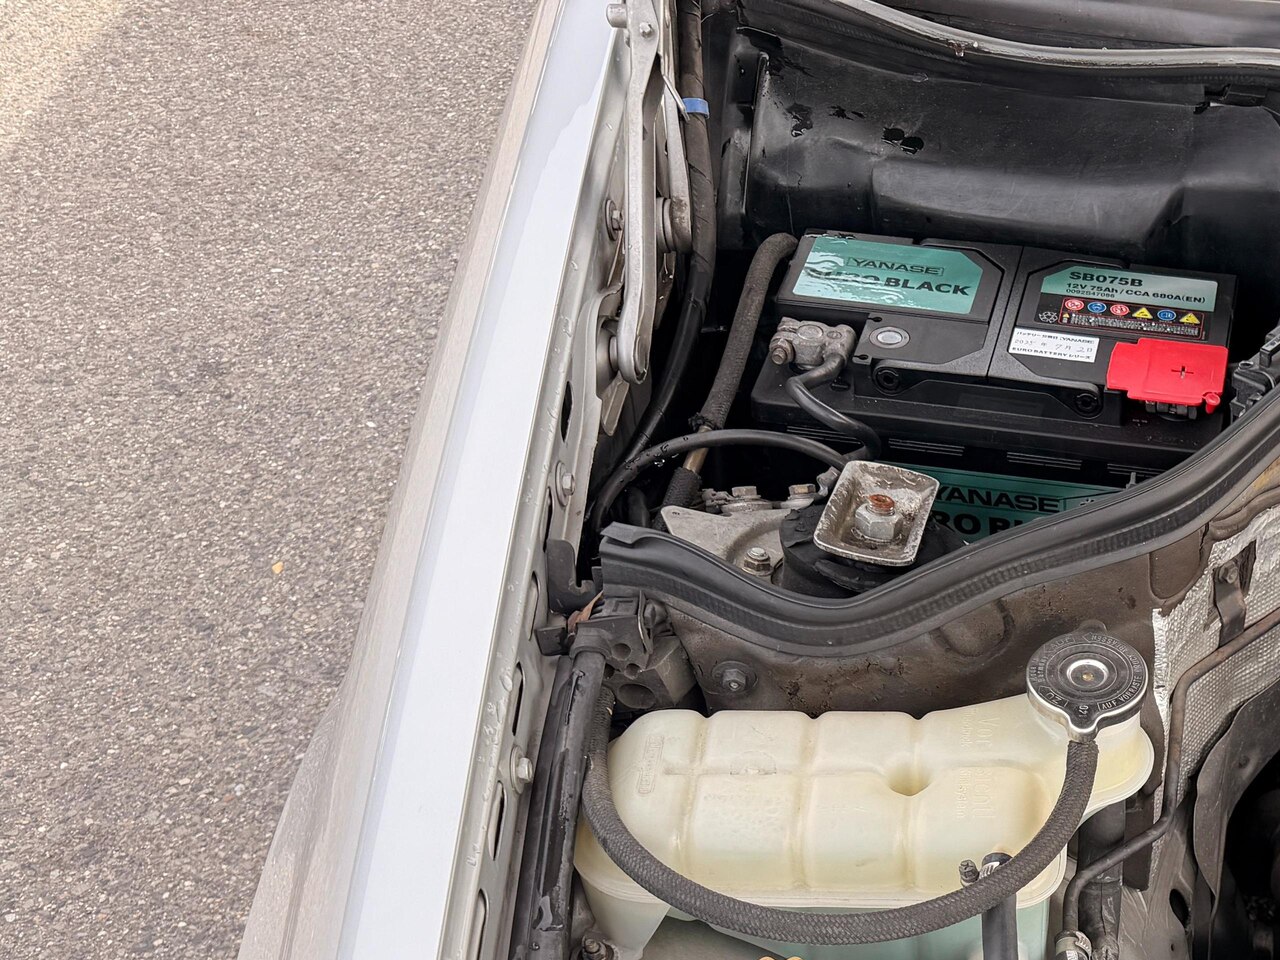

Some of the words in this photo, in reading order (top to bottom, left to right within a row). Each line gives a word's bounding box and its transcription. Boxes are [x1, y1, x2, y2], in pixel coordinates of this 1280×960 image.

[850, 258, 939, 275] YANASE
[884, 276, 972, 296] BLACK
[1069, 271, 1143, 287] SB075B
[1066, 282, 1087, 290] 12V
[1090, 285, 1119, 294] 75Ah
[1126, 289, 1151, 298] CCA
[936, 485, 1061, 513] YANASE
[1102, 699, 1118, 711] AUF
